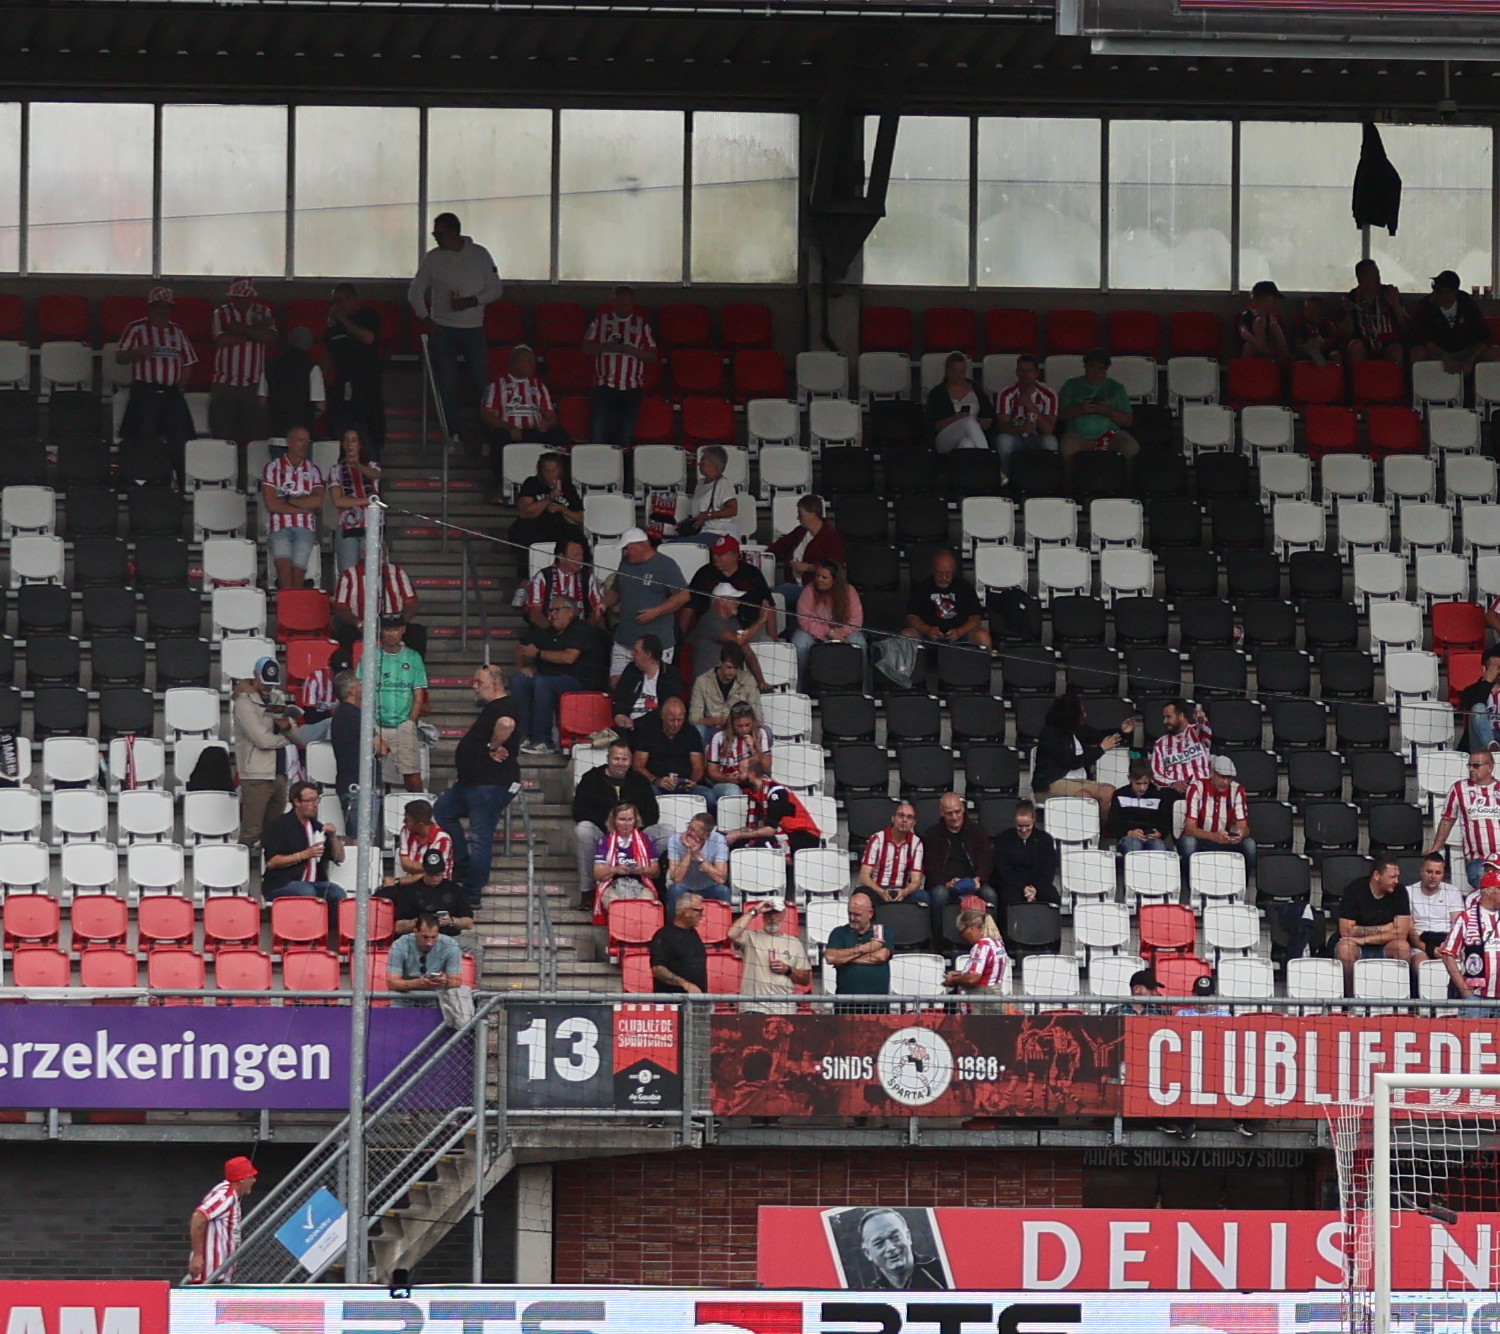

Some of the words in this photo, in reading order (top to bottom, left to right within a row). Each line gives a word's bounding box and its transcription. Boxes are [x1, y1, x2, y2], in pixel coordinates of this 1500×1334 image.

[618, 1019, 673, 1033] CLUBLIEFDE
[516, 1017, 600, 1082] 13
[957, 1056, 998, 1080] 1888
[1149, 1028, 1497, 1106] CLUBLIEFDE
[887, 1077, 925, 1100] SPARTA
[1023, 1220, 1356, 1289] DENIS
